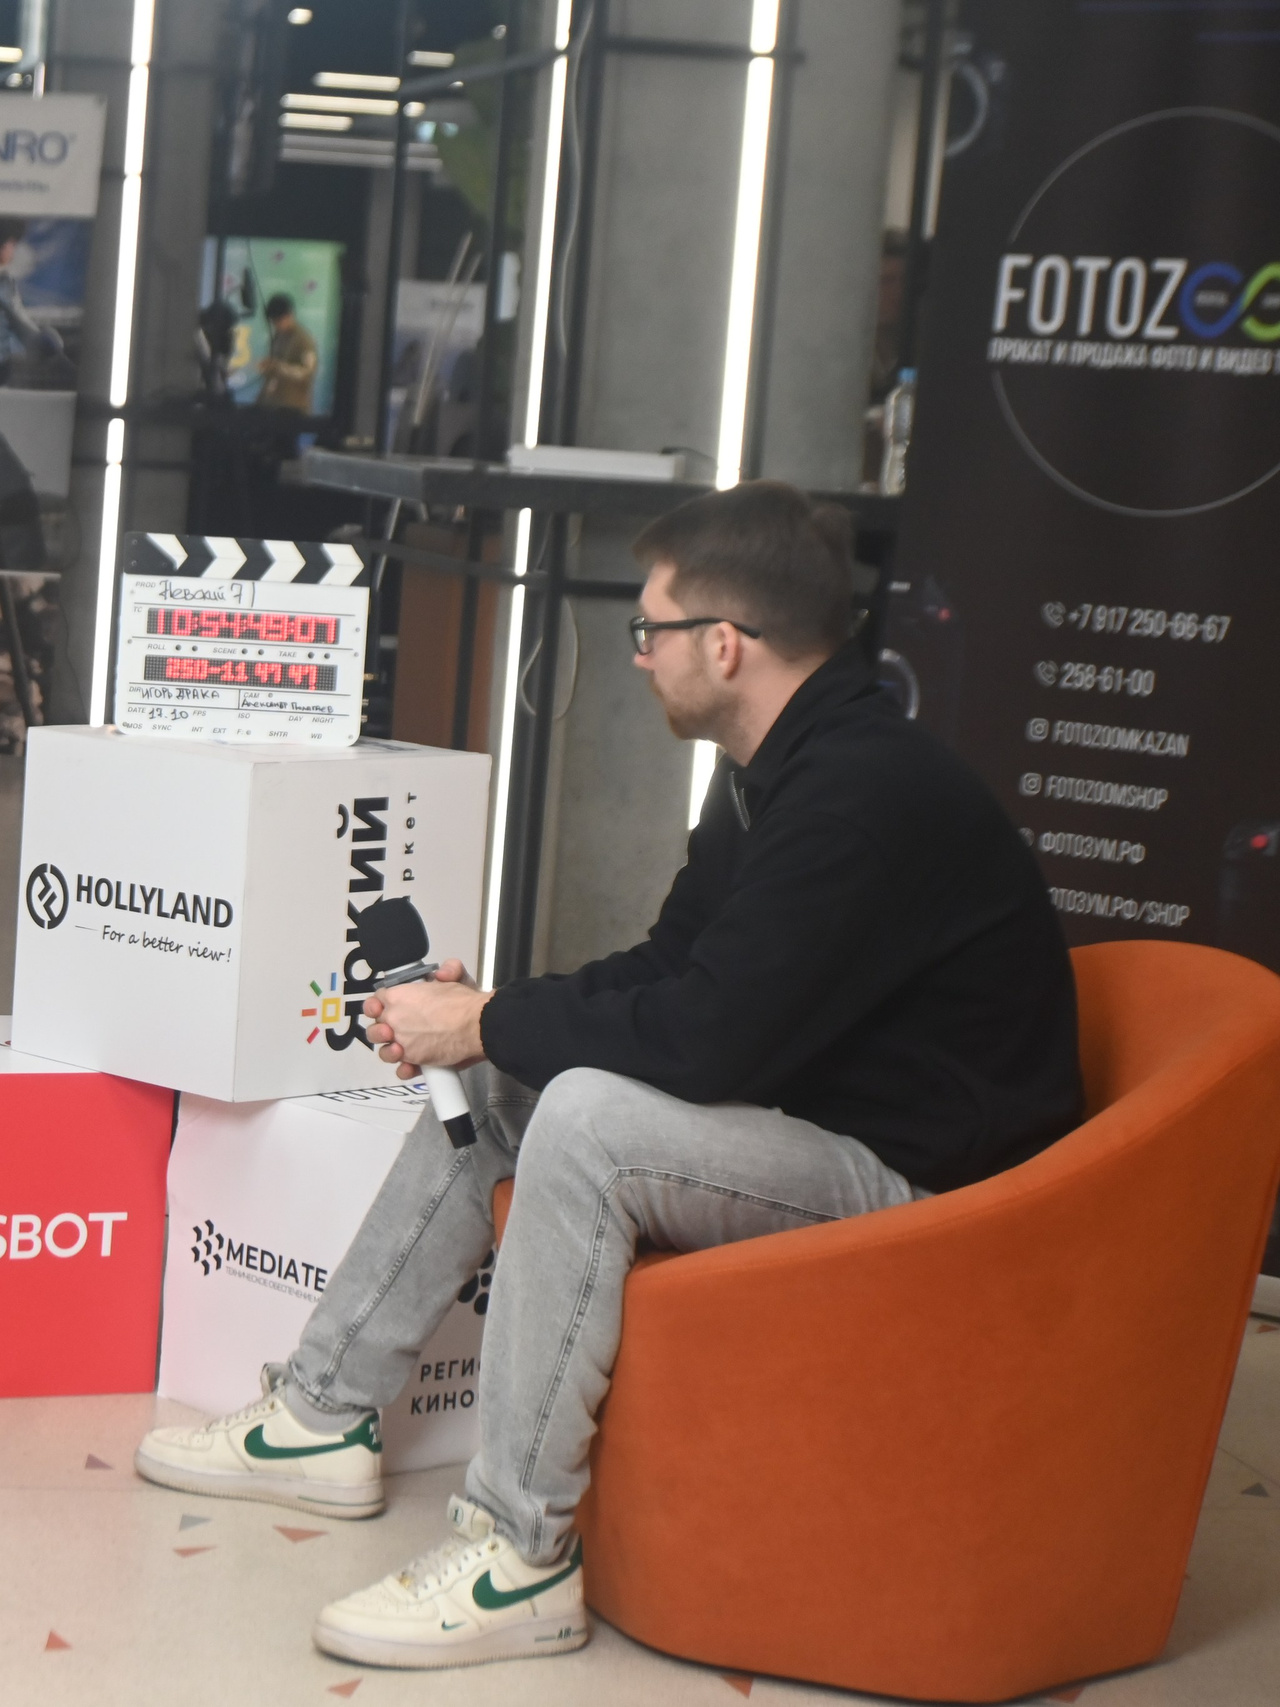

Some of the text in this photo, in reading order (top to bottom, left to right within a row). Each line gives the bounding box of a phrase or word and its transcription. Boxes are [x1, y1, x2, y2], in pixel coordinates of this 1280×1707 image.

[988, 336, 1052, 365] ПРОКАТ
[1069, 340, 1149, 370] ПРОДАЖА
[1149, 344, 1198, 371] ФОТО
[135, 581, 156, 589] PROD
[1092, 604, 1129, 633] 917
[1127, 607, 1232, 643] 250-66-67
[147, 643, 166, 651] ROLL
[212, 647, 238, 655] SCENE
[278, 650, 297, 658] TAKE
[1058, 661, 1156, 697] 258-61-00
[127, 706, 146, 714] DATE
[268, 730, 289, 738] SHTR
[1052, 720, 1190, 758] FOTOZOOMKAZAN
[1045, 775, 1168, 811] FOTOZOOMSHOP
[76, 873, 234, 928] HOLLYLAND
[102, 925, 125, 942] For
[128, 934, 140, 945] a
[142, 931, 184, 954] better
[226, 1238, 328, 1293] MEDIATE
[421, 1358, 480, 1382] РЕГИ
[411, 1390, 474, 1415] КИНО
